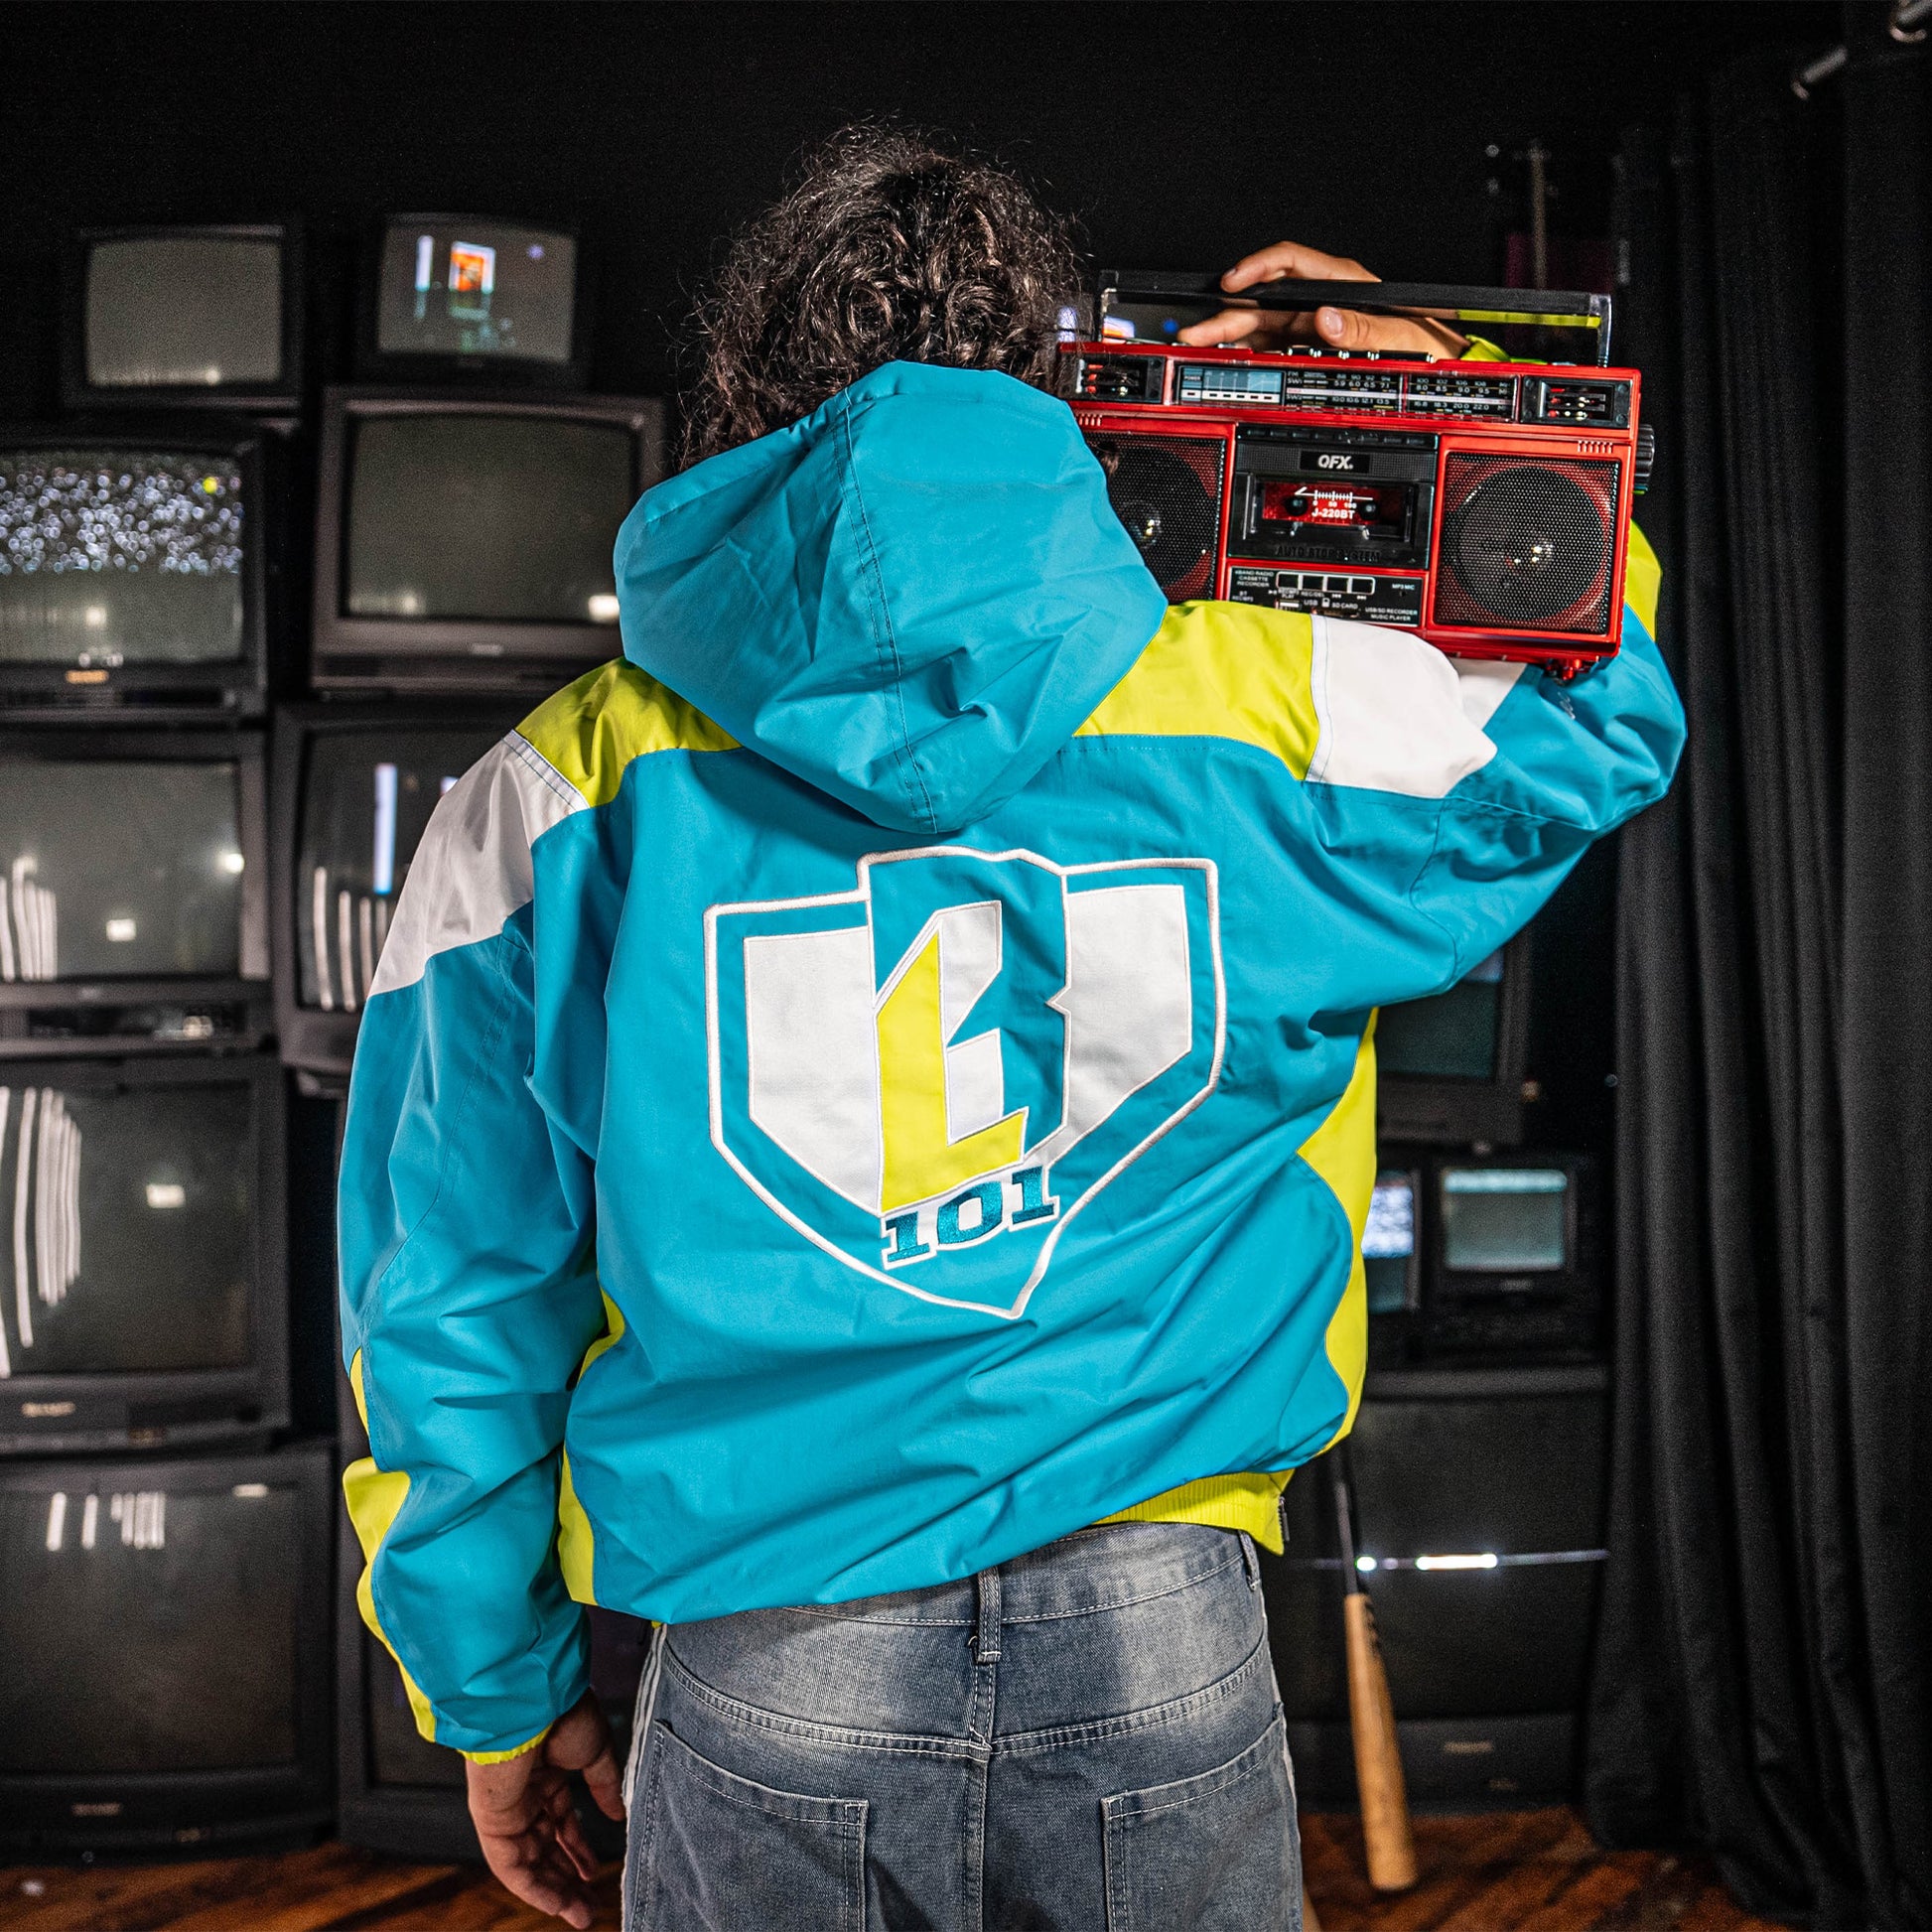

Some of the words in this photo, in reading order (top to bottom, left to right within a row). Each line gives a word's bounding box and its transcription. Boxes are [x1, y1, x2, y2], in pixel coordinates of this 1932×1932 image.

[1311, 507, 1355, 519] J-220BT
[1275, 546, 1305, 557] AUTO
[885, 1166, 1055, 1263] 101
